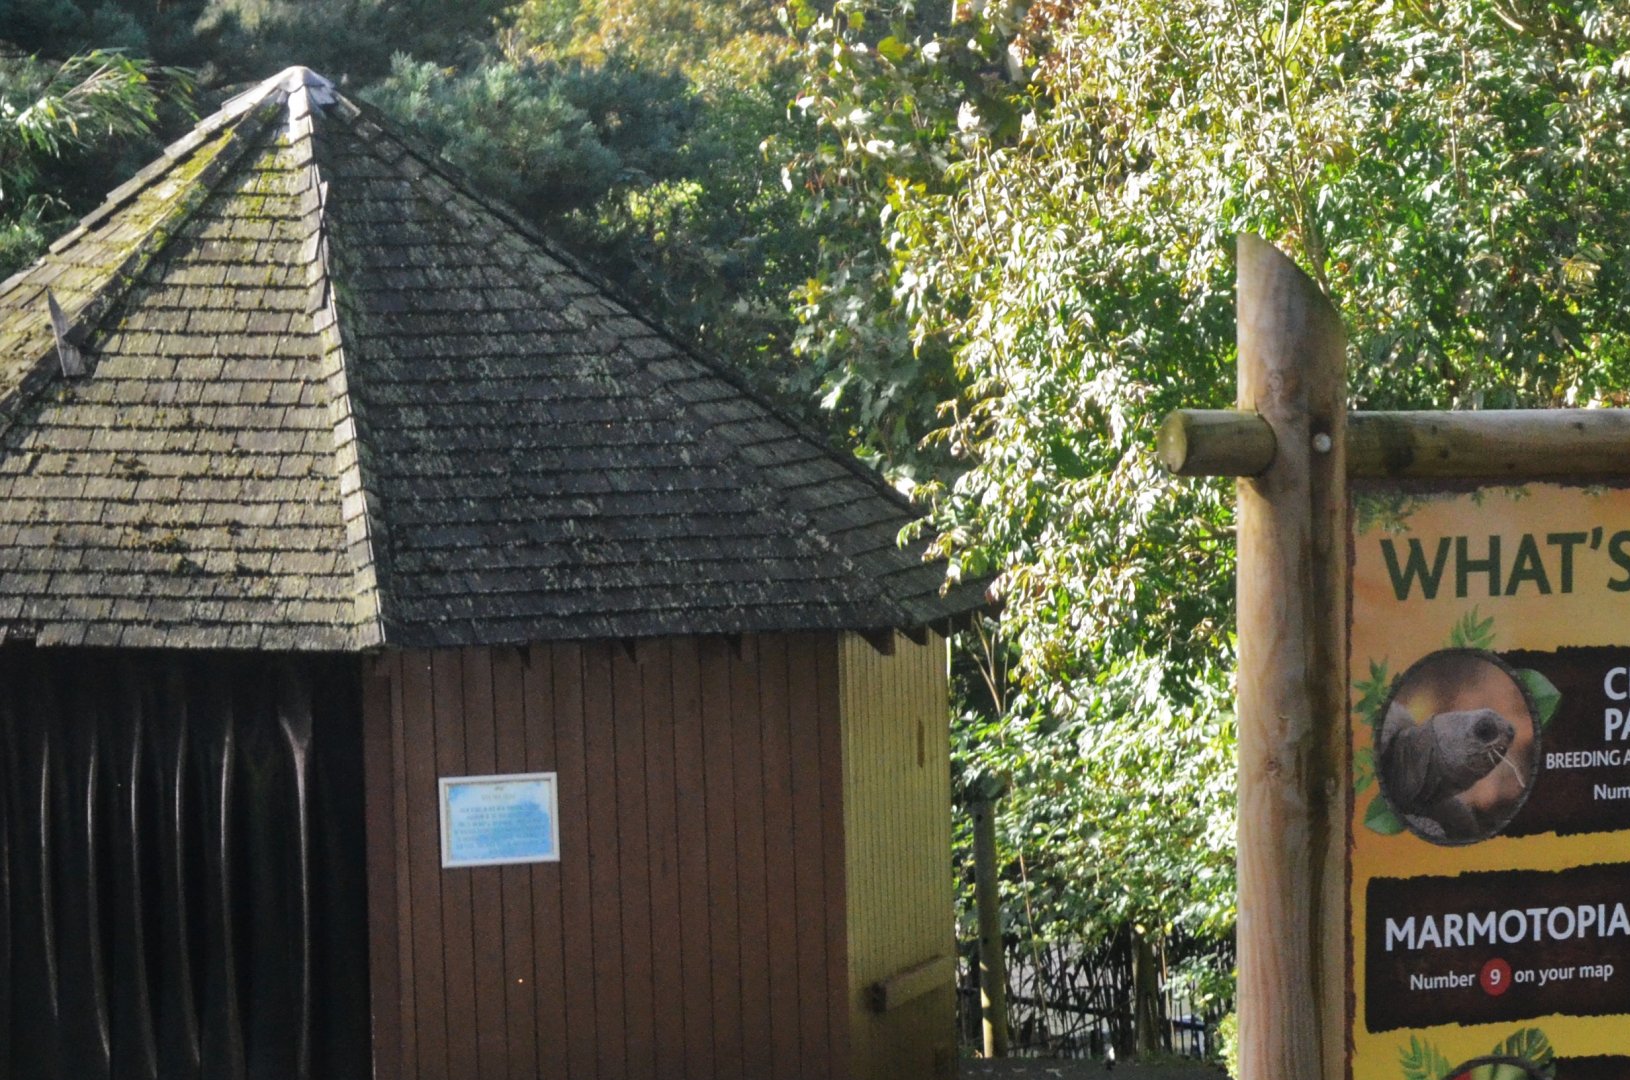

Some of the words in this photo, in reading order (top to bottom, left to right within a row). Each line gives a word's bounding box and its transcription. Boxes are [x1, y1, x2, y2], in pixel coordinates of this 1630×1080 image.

[1545, 749, 1621, 770] BREEDING
[1409, 969, 1476, 991] Number
[1490, 968, 1501, 987] 9
[1514, 969, 1535, 984] on
[1538, 966, 1577, 988] your
[1579, 964, 1614, 984] map
